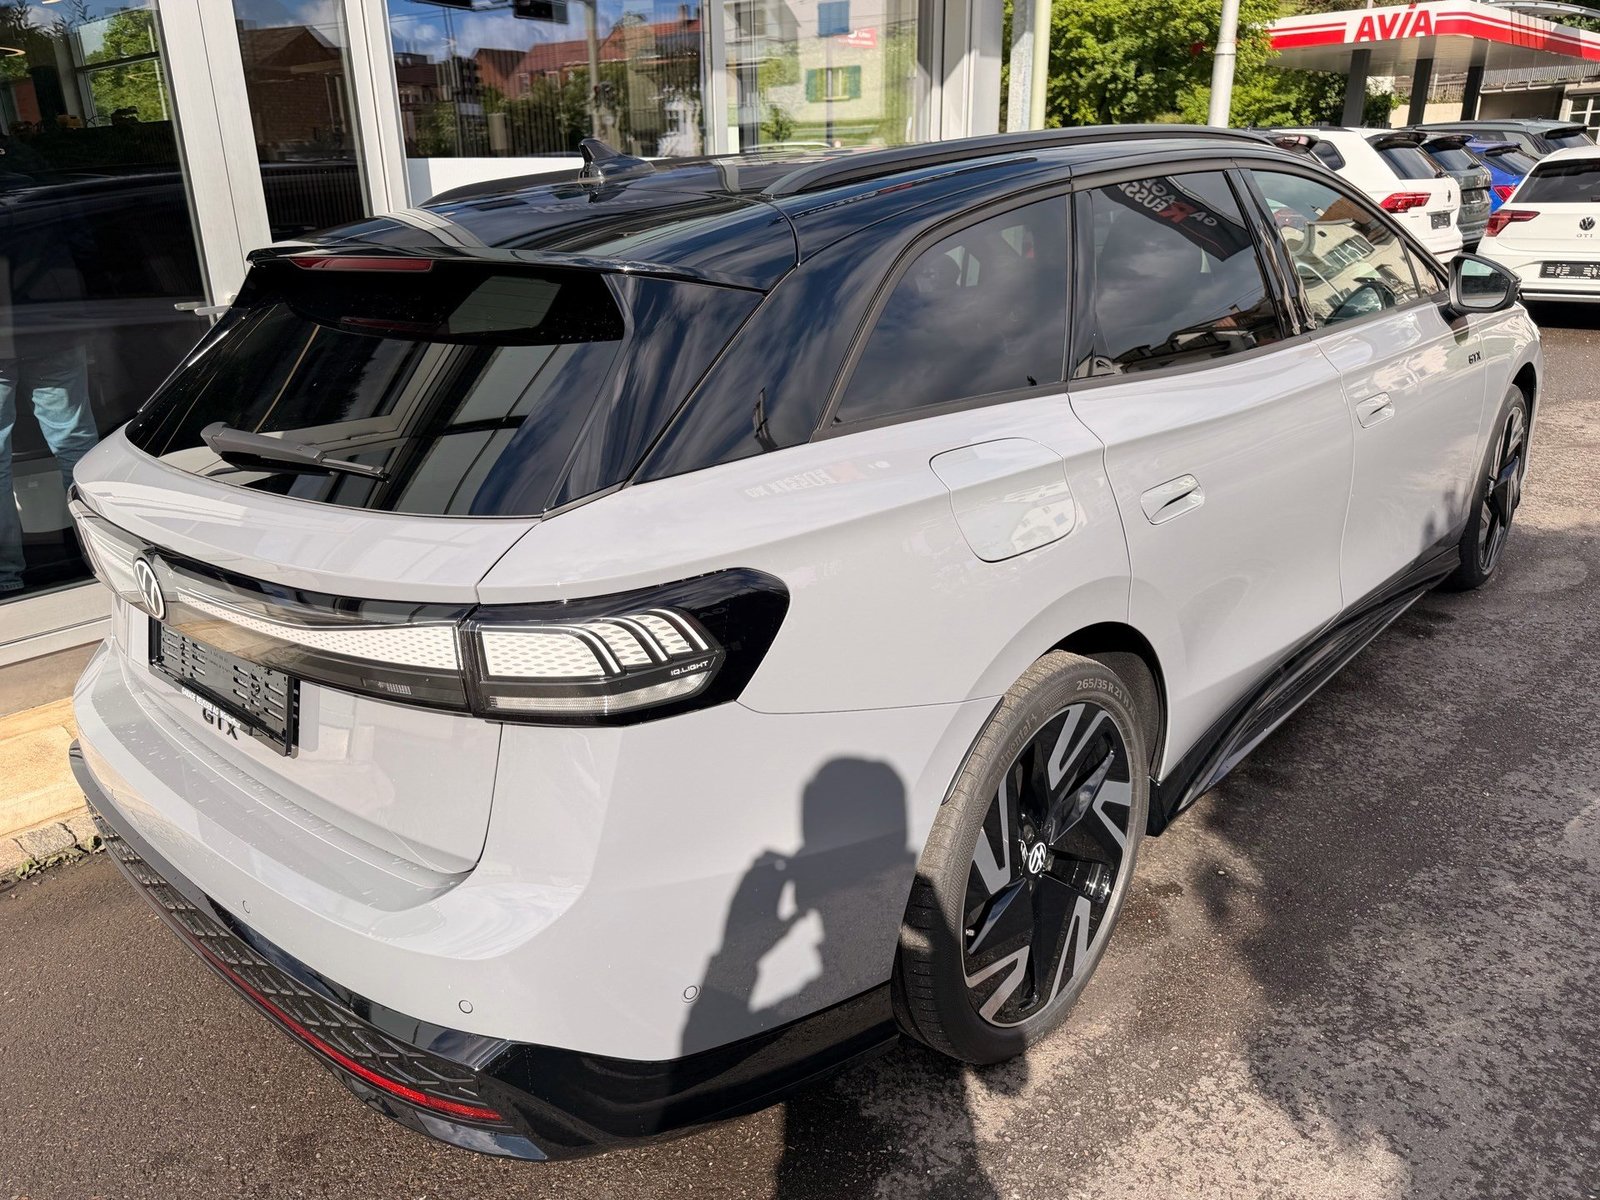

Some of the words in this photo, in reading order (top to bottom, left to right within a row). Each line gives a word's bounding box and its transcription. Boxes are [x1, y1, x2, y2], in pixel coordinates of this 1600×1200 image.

[1354, 3, 1433, 43] AVIA
[1468, 351, 1481, 364] GTX
[670, 660, 709, 676] IQ.LIGHT
[1076, 678, 1107, 691] 265/35
[203, 707, 238, 741] GTX
